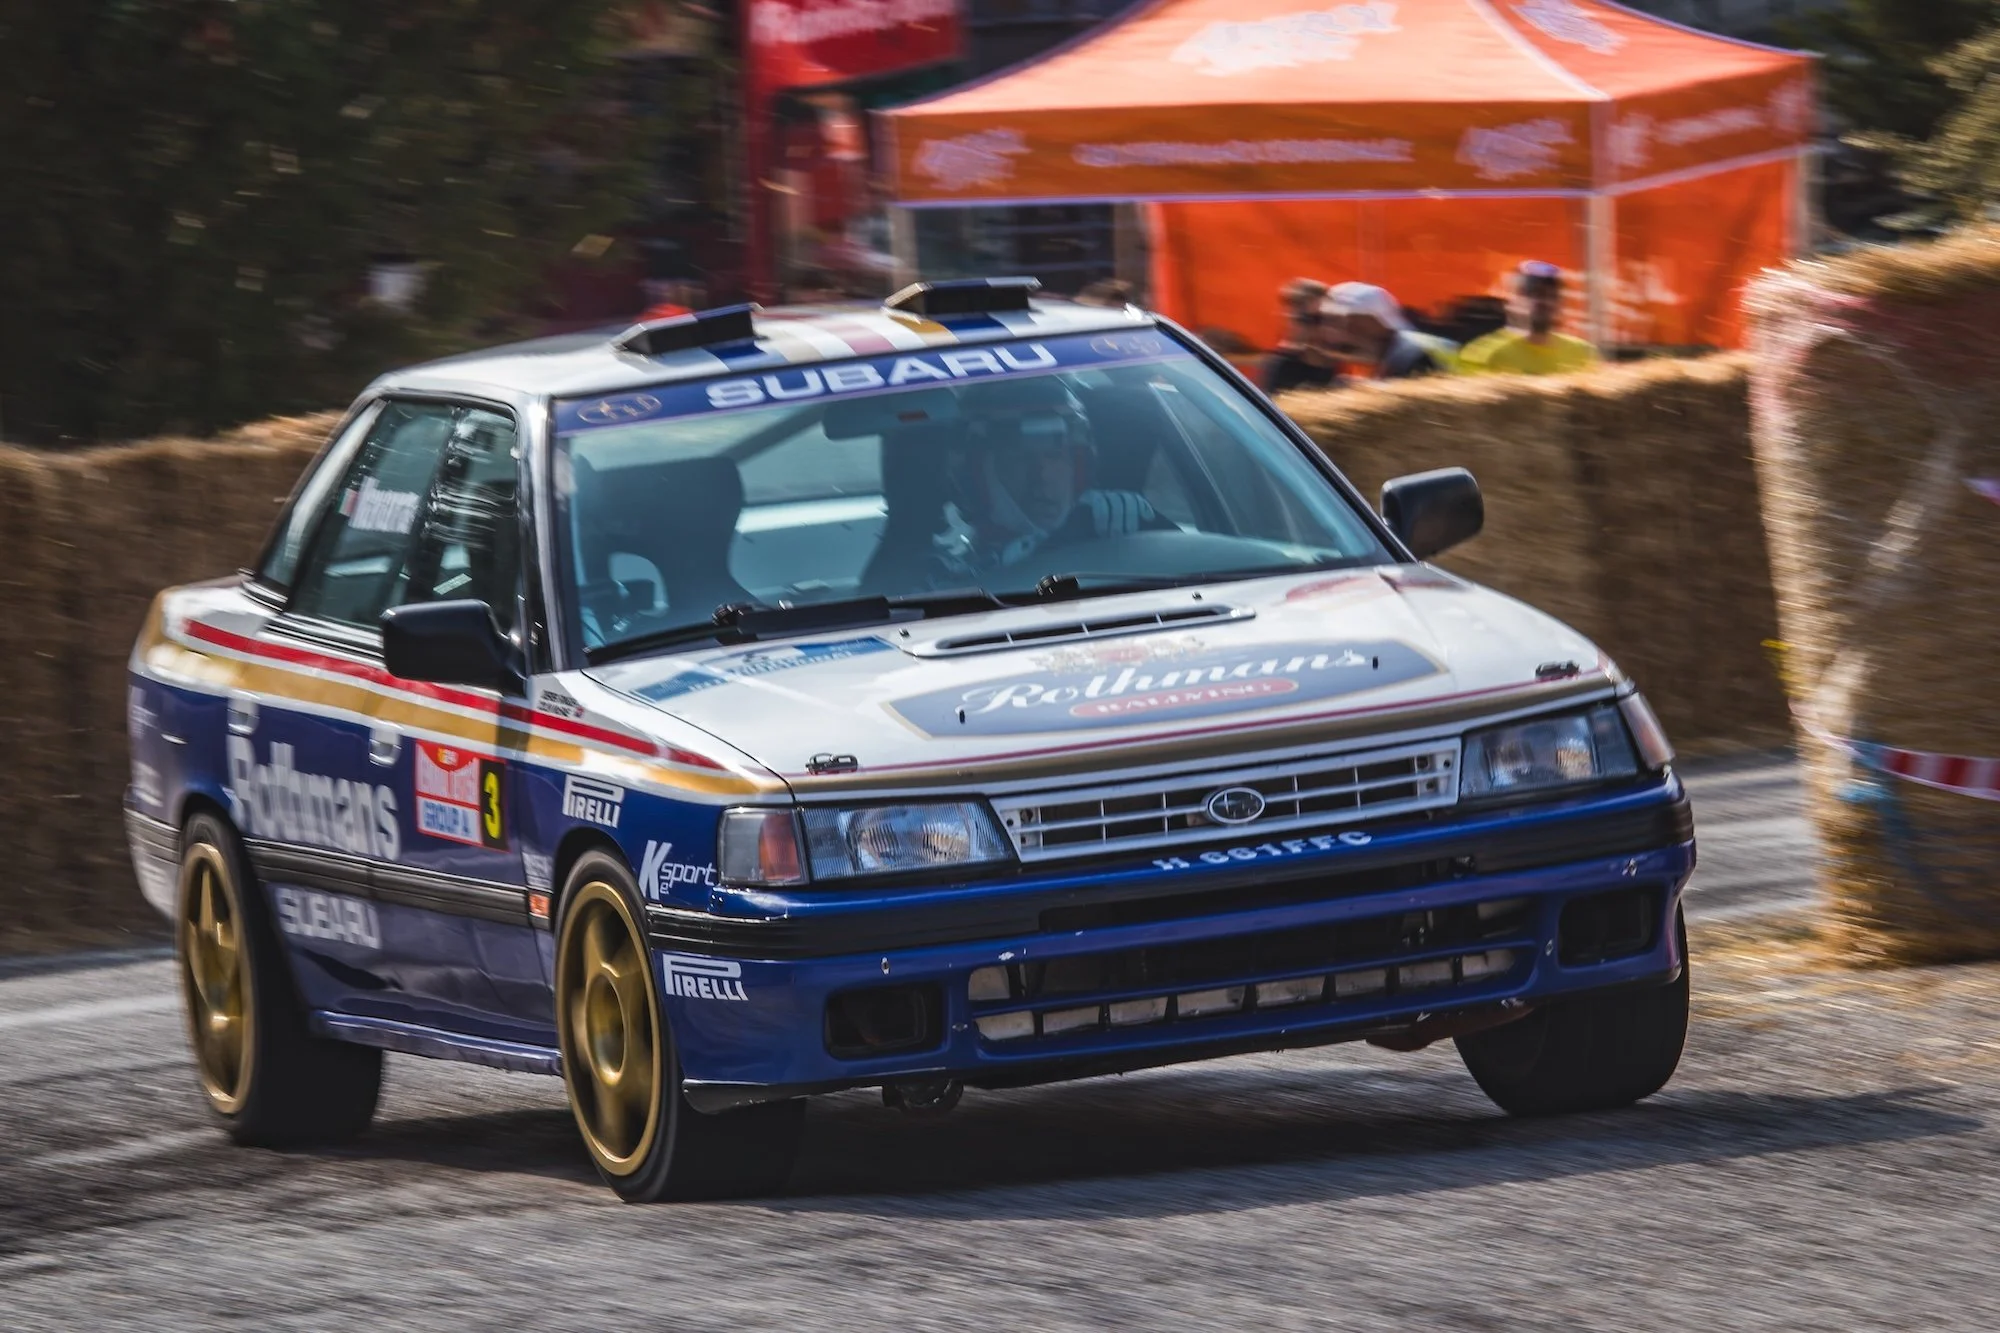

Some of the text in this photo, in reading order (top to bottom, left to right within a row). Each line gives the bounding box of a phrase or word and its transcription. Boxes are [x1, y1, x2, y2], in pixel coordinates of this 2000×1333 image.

[706, 343, 1059, 408] SUBARU
[955, 649, 1368, 715] Rothmans
[226, 734, 400, 861] Rothmans
[484, 771, 501, 839] 3
[562, 774, 625, 829] PIRELLI
[662, 953, 749, 1001] PIRELLI
